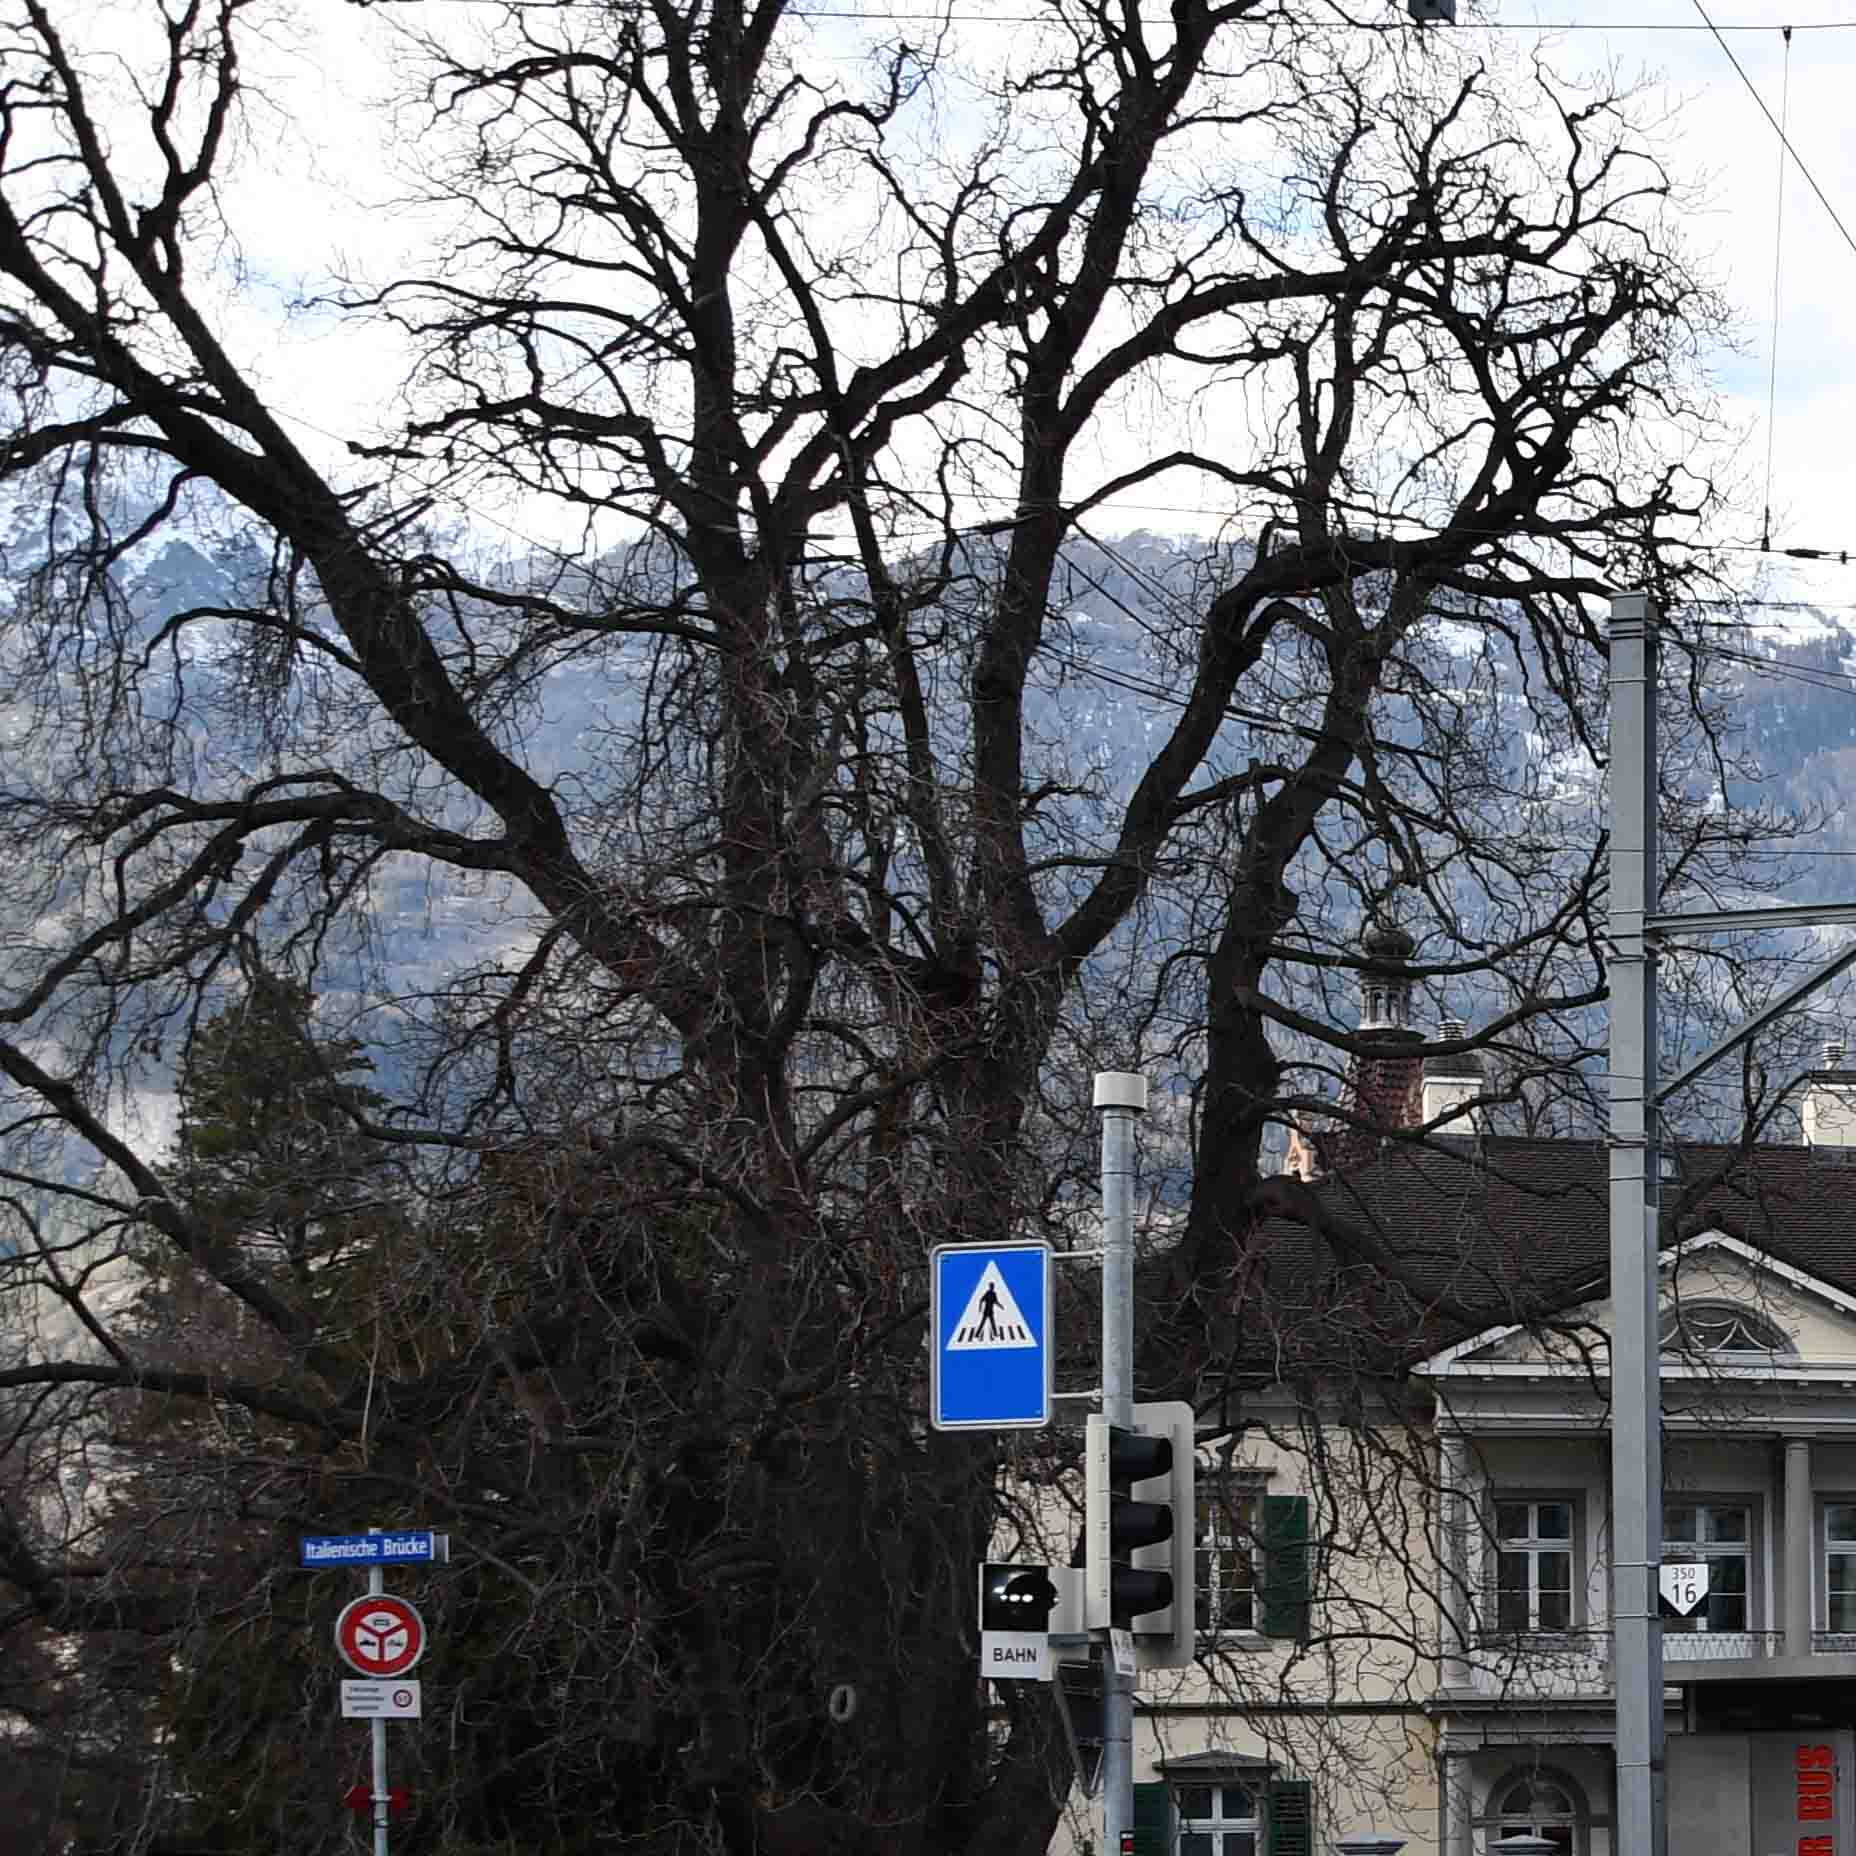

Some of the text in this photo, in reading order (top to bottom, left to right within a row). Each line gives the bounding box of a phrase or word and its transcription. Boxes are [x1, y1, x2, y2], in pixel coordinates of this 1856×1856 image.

[305, 1537, 428, 1560] Italienische Brücke
[1672, 1567, 1696, 1580] 350
[1672, 1583, 1697, 1604] 16
[993, 1647, 1037, 1663] BAHN
[1796, 1744, 1834, 1821] BUS
